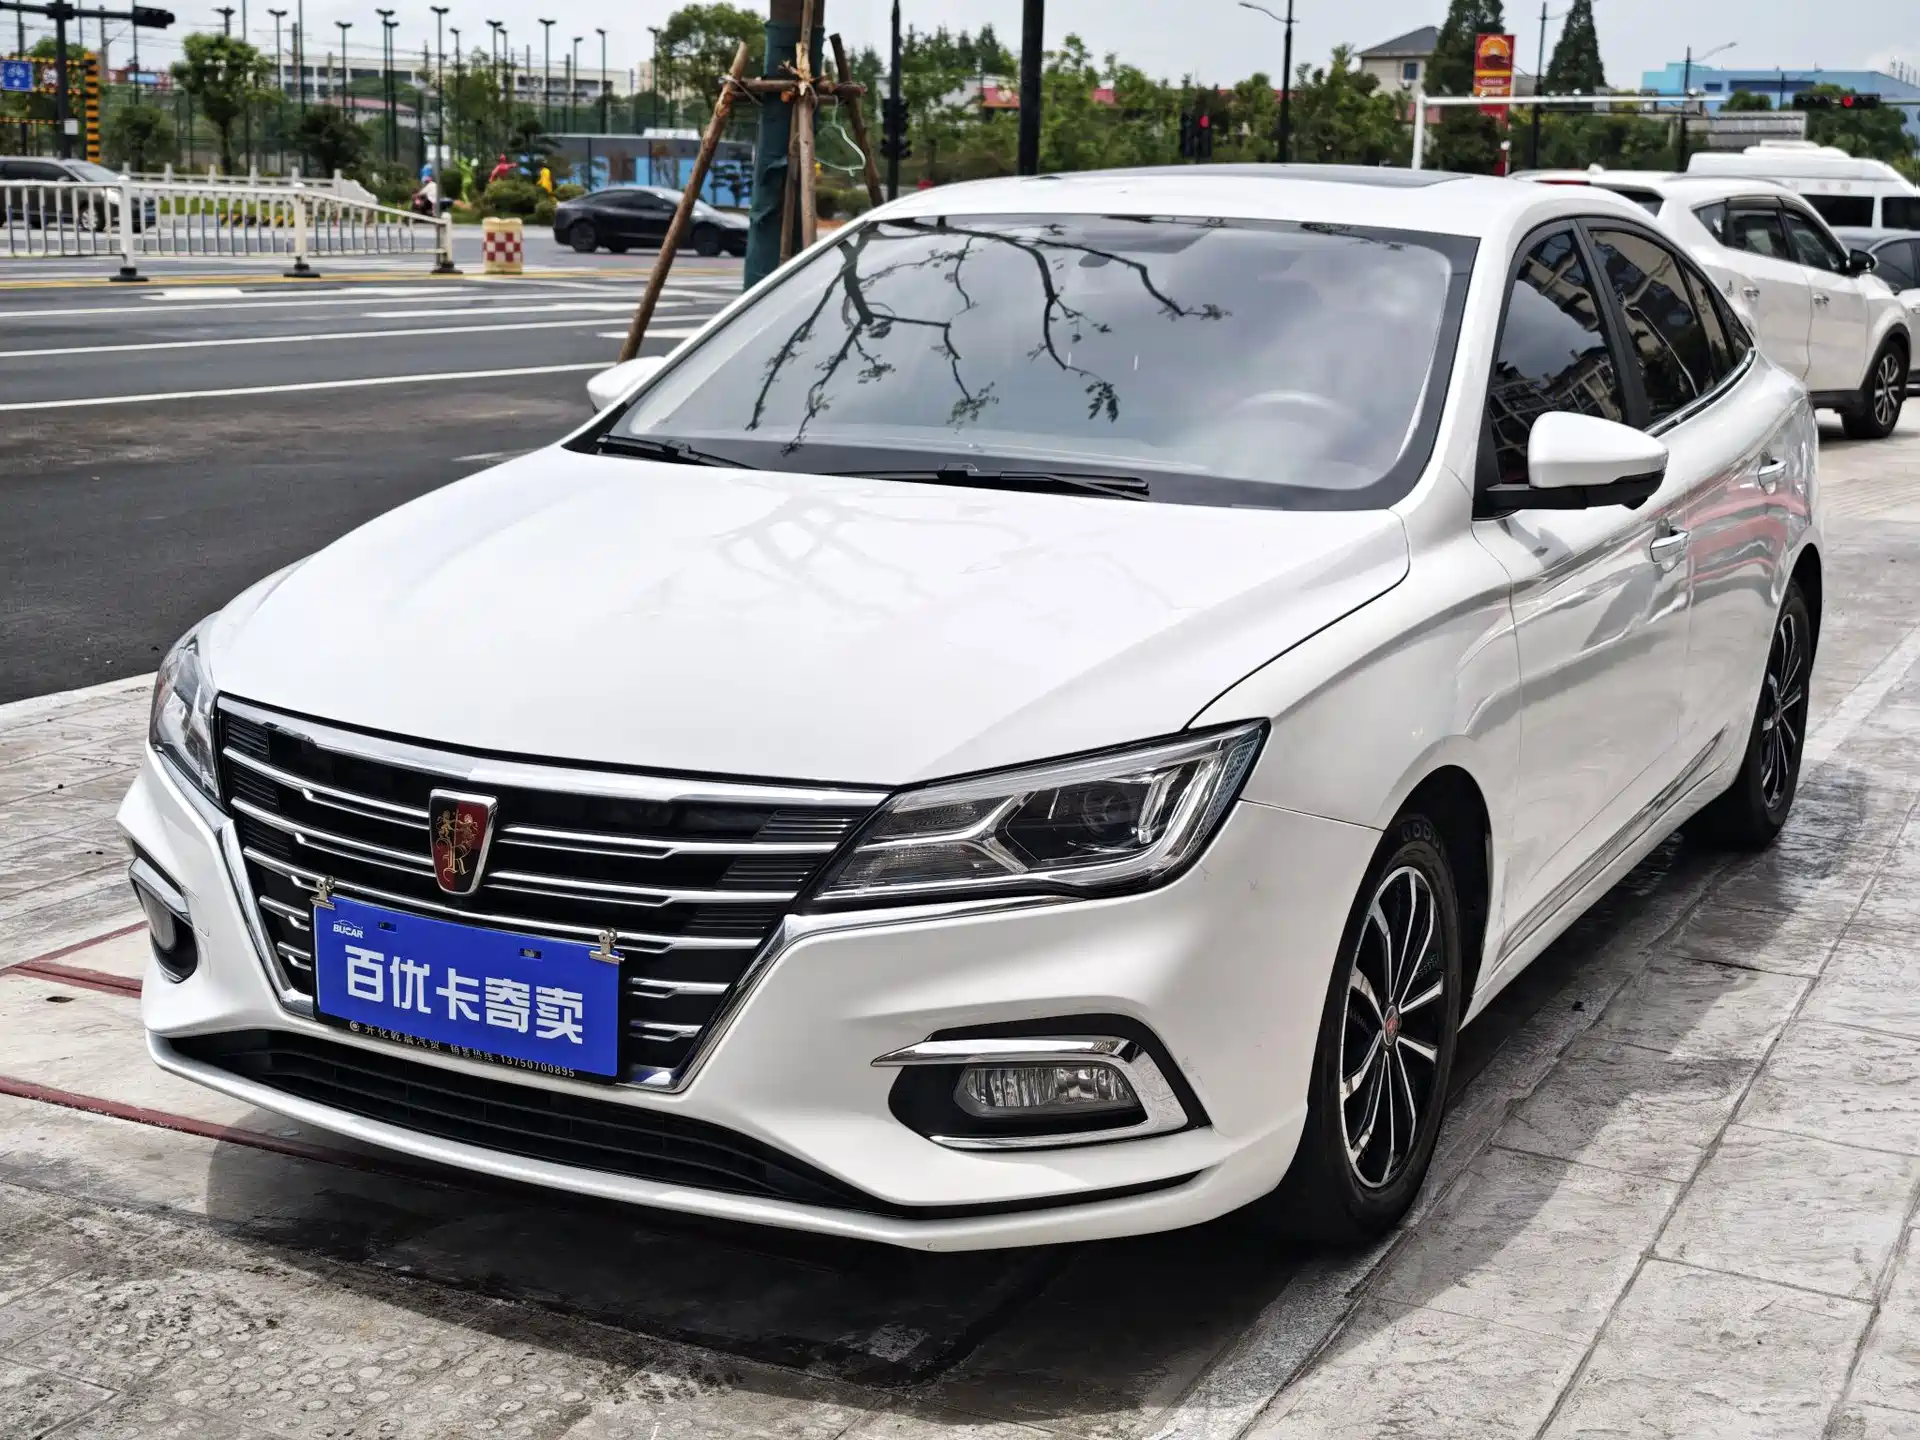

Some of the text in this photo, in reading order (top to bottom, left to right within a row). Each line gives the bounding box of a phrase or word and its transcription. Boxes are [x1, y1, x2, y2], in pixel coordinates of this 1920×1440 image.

[332, 924, 363, 939] BUCAR
[345, 945, 584, 1044] 百优卡寄卖
